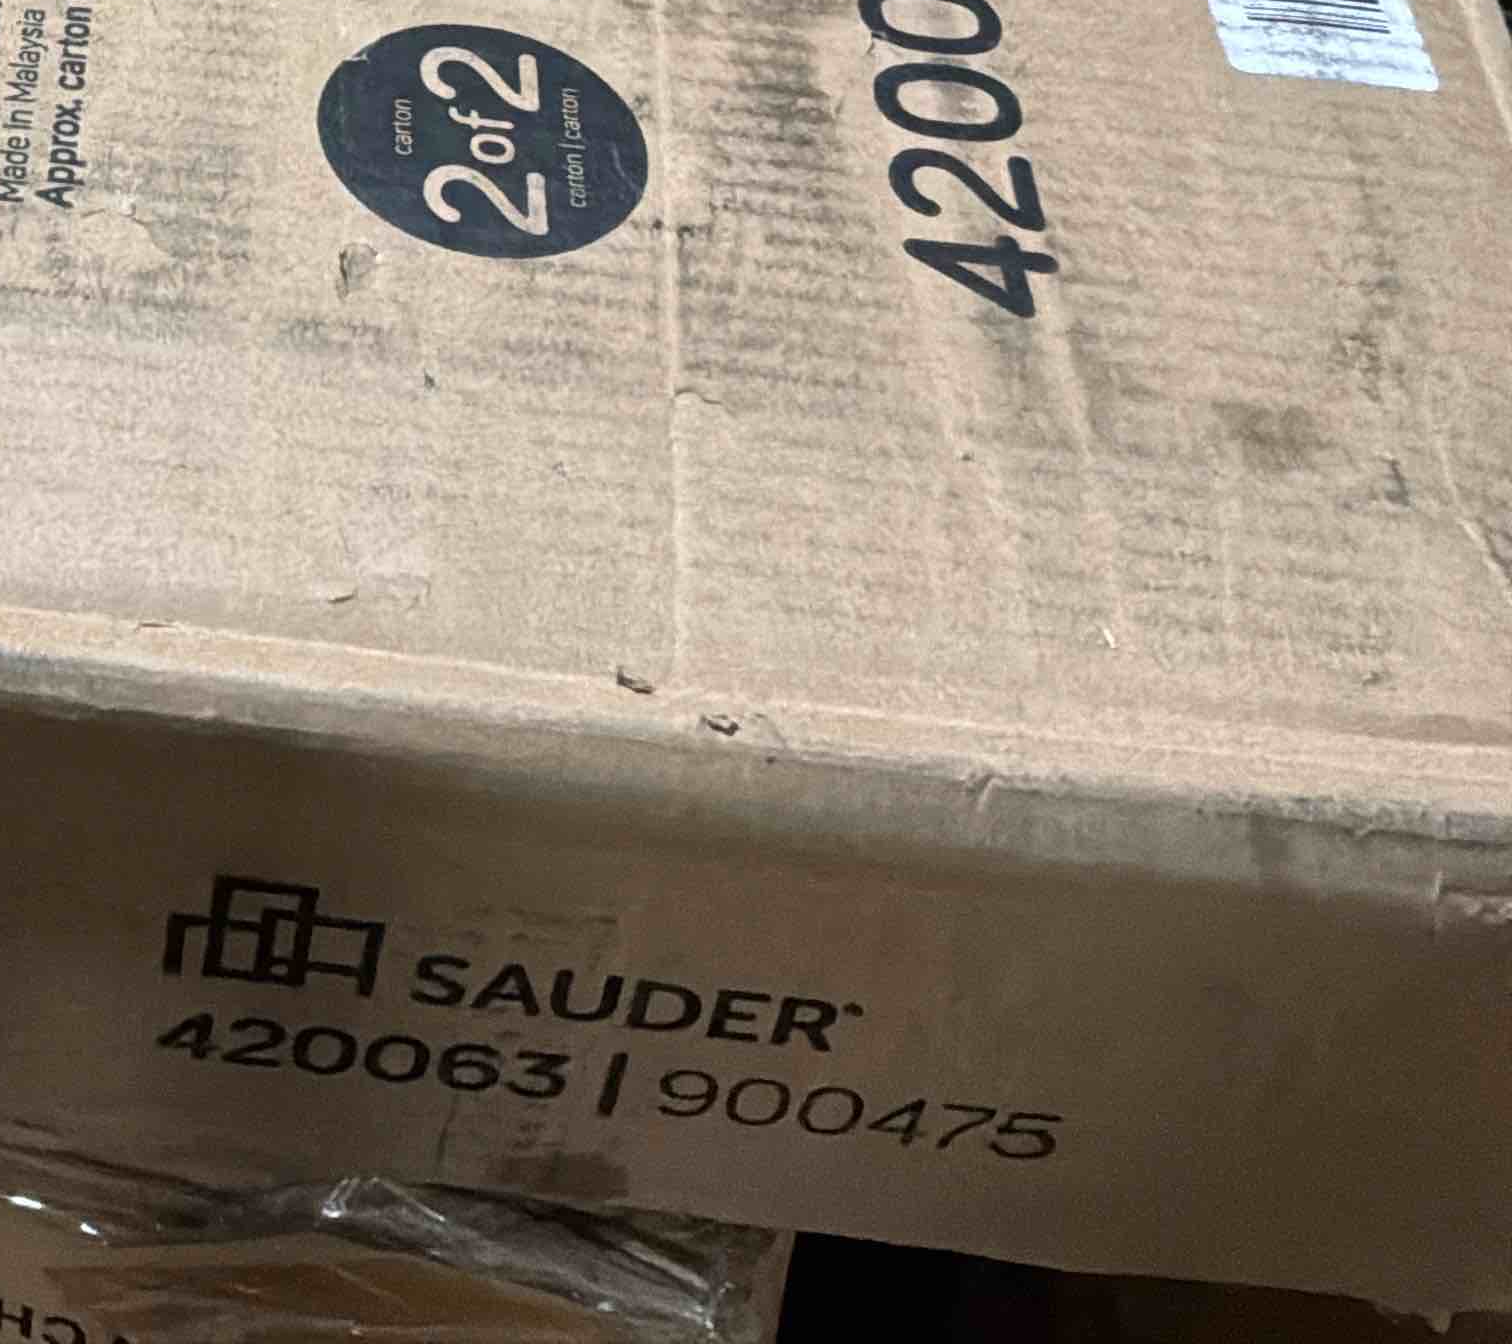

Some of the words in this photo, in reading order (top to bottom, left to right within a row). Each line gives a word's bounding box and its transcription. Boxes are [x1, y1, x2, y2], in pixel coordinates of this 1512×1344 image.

[4, 7, 48, 104] Malaysia
[56, 7, 93, 91] carton
[419, 46, 540, 112] 2
[391, 99, 413, 156] carton
[448, 104, 516, 165] of
[560, 88, 581, 140] carton
[35, 98, 85, 208] Approx.
[422, 163, 550, 236] 2
[156, 1012, 570, 1103] 420063
[657, 1069, 1062, 1161] 900475
